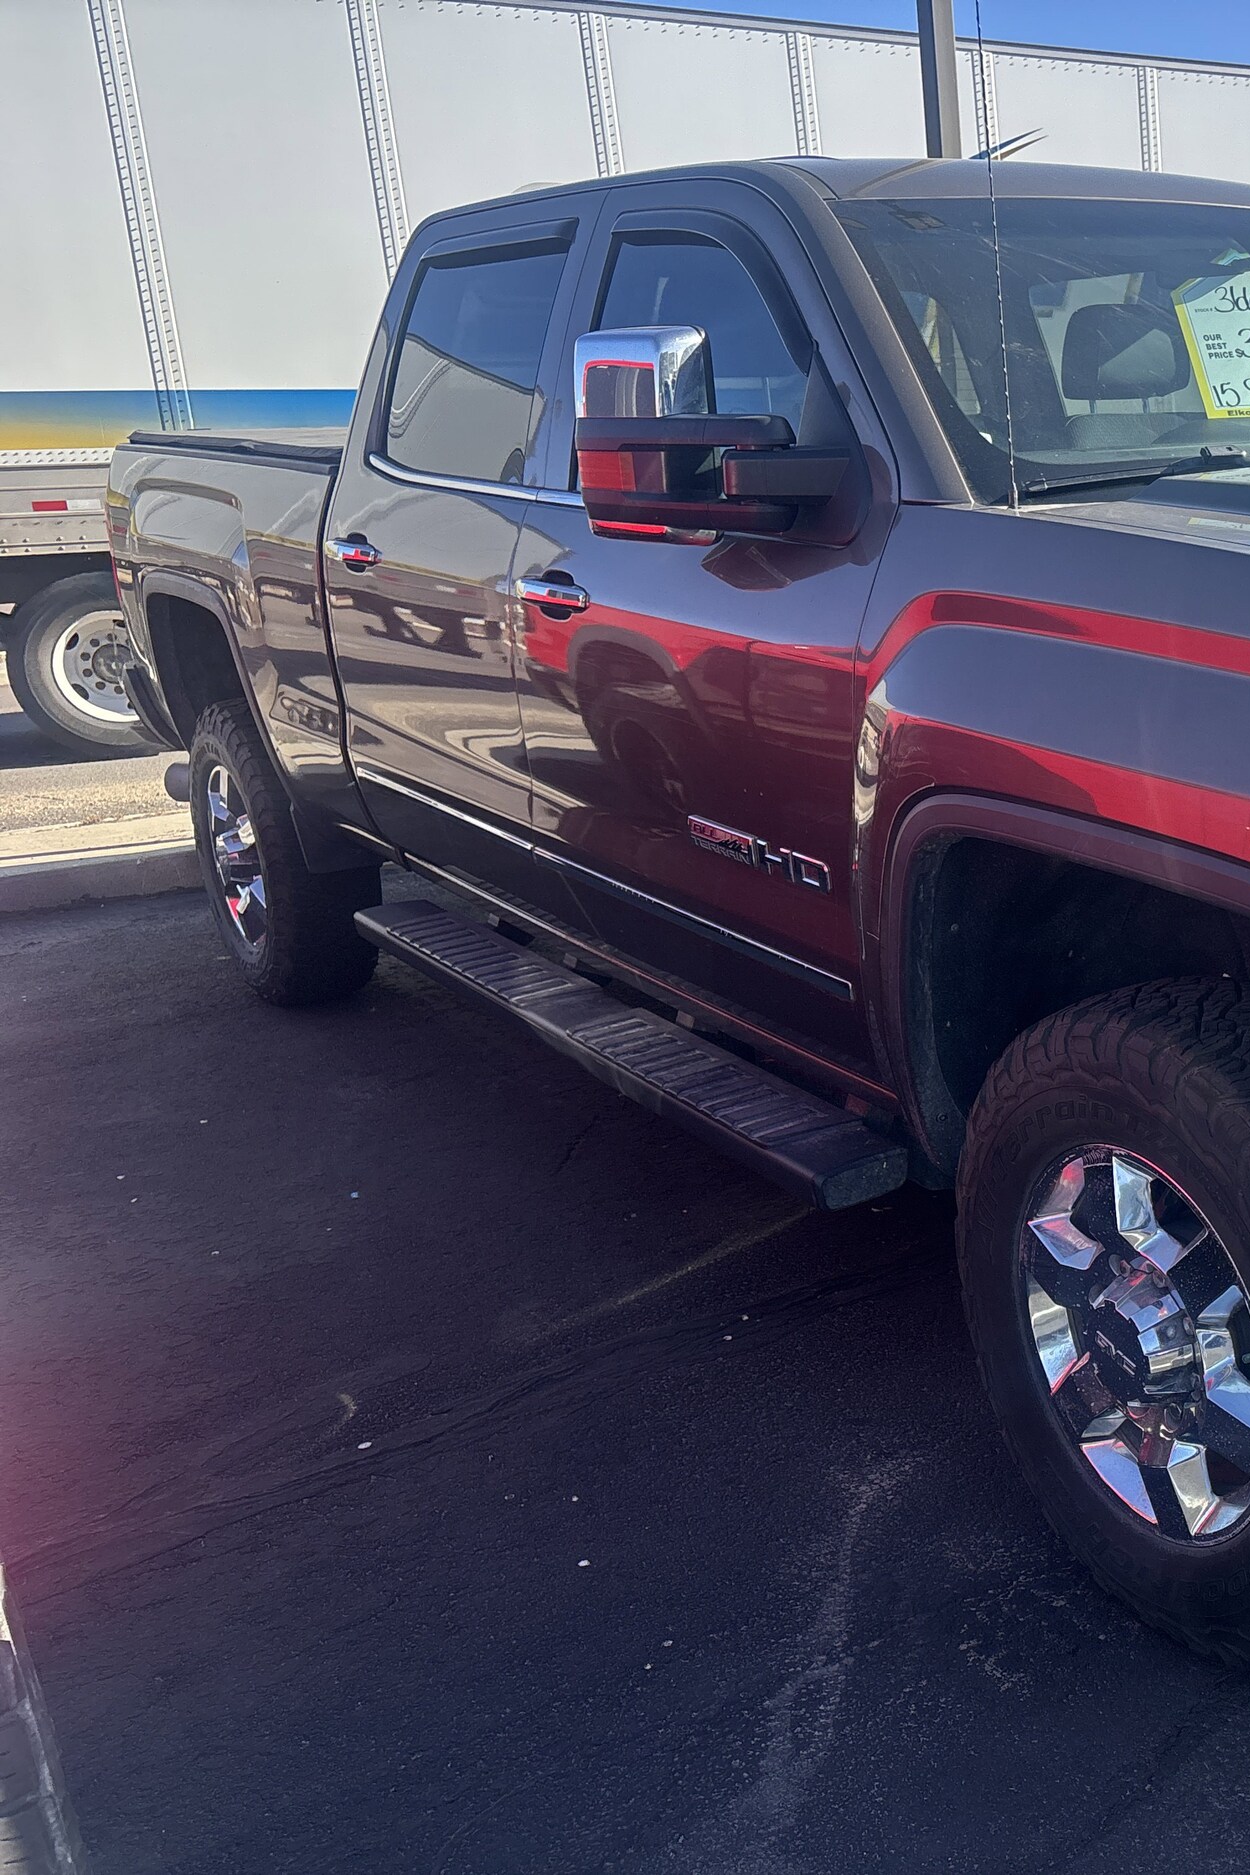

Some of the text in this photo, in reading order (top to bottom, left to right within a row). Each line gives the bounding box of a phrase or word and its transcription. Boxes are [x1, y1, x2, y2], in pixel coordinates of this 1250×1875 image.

[1203, 333, 1222, 341] OUR
[1206, 342, 1227, 351] BEST
[1208, 350, 1235, 359] PRICE
[1213, 382, 1241, 407] 15
[690, 834, 751, 865] TERRAIN
[756, 838, 832, 894] HD
